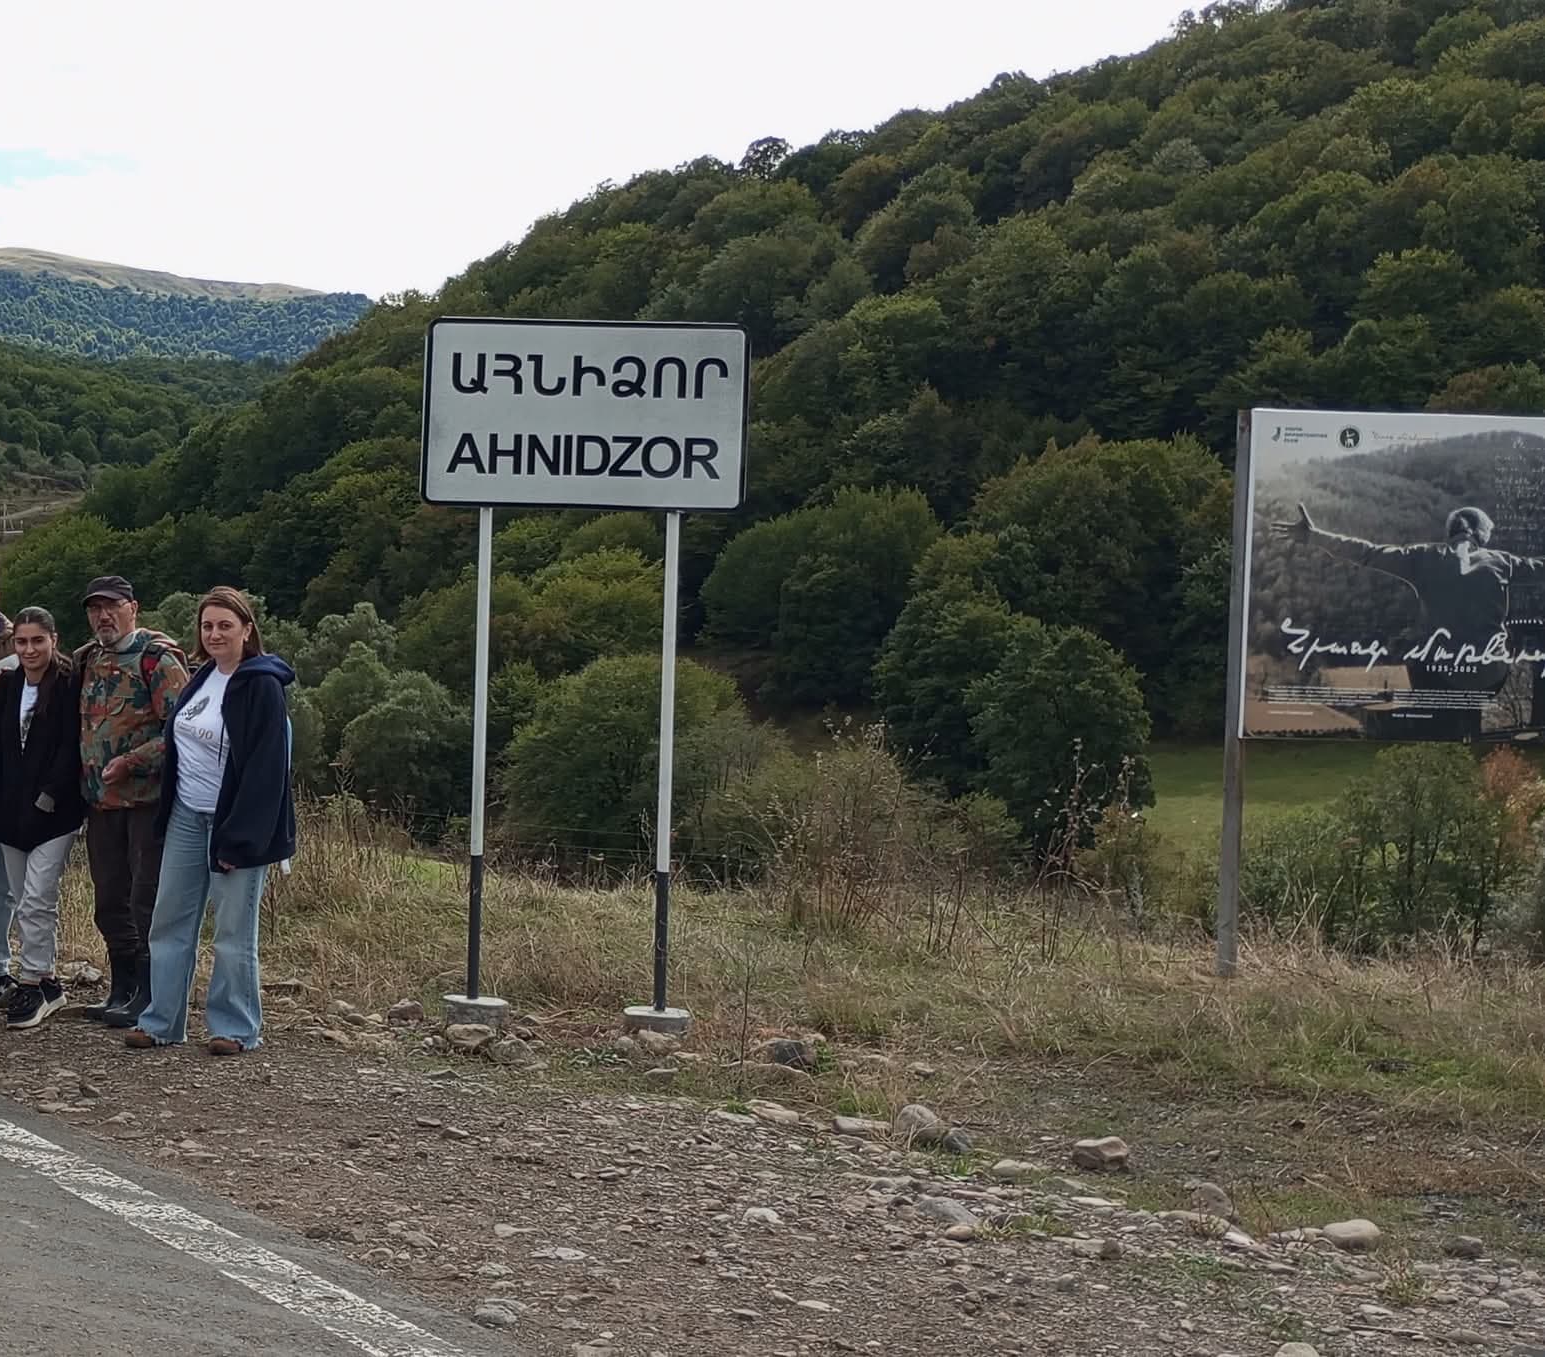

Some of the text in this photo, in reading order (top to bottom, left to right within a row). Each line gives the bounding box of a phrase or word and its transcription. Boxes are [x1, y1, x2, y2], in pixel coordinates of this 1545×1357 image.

[451, 352, 729, 399] ԱՀՆԻՁՈՐ
[446, 432, 721, 481] AHNIDZOR
[198, 727, 214, 740] 90
